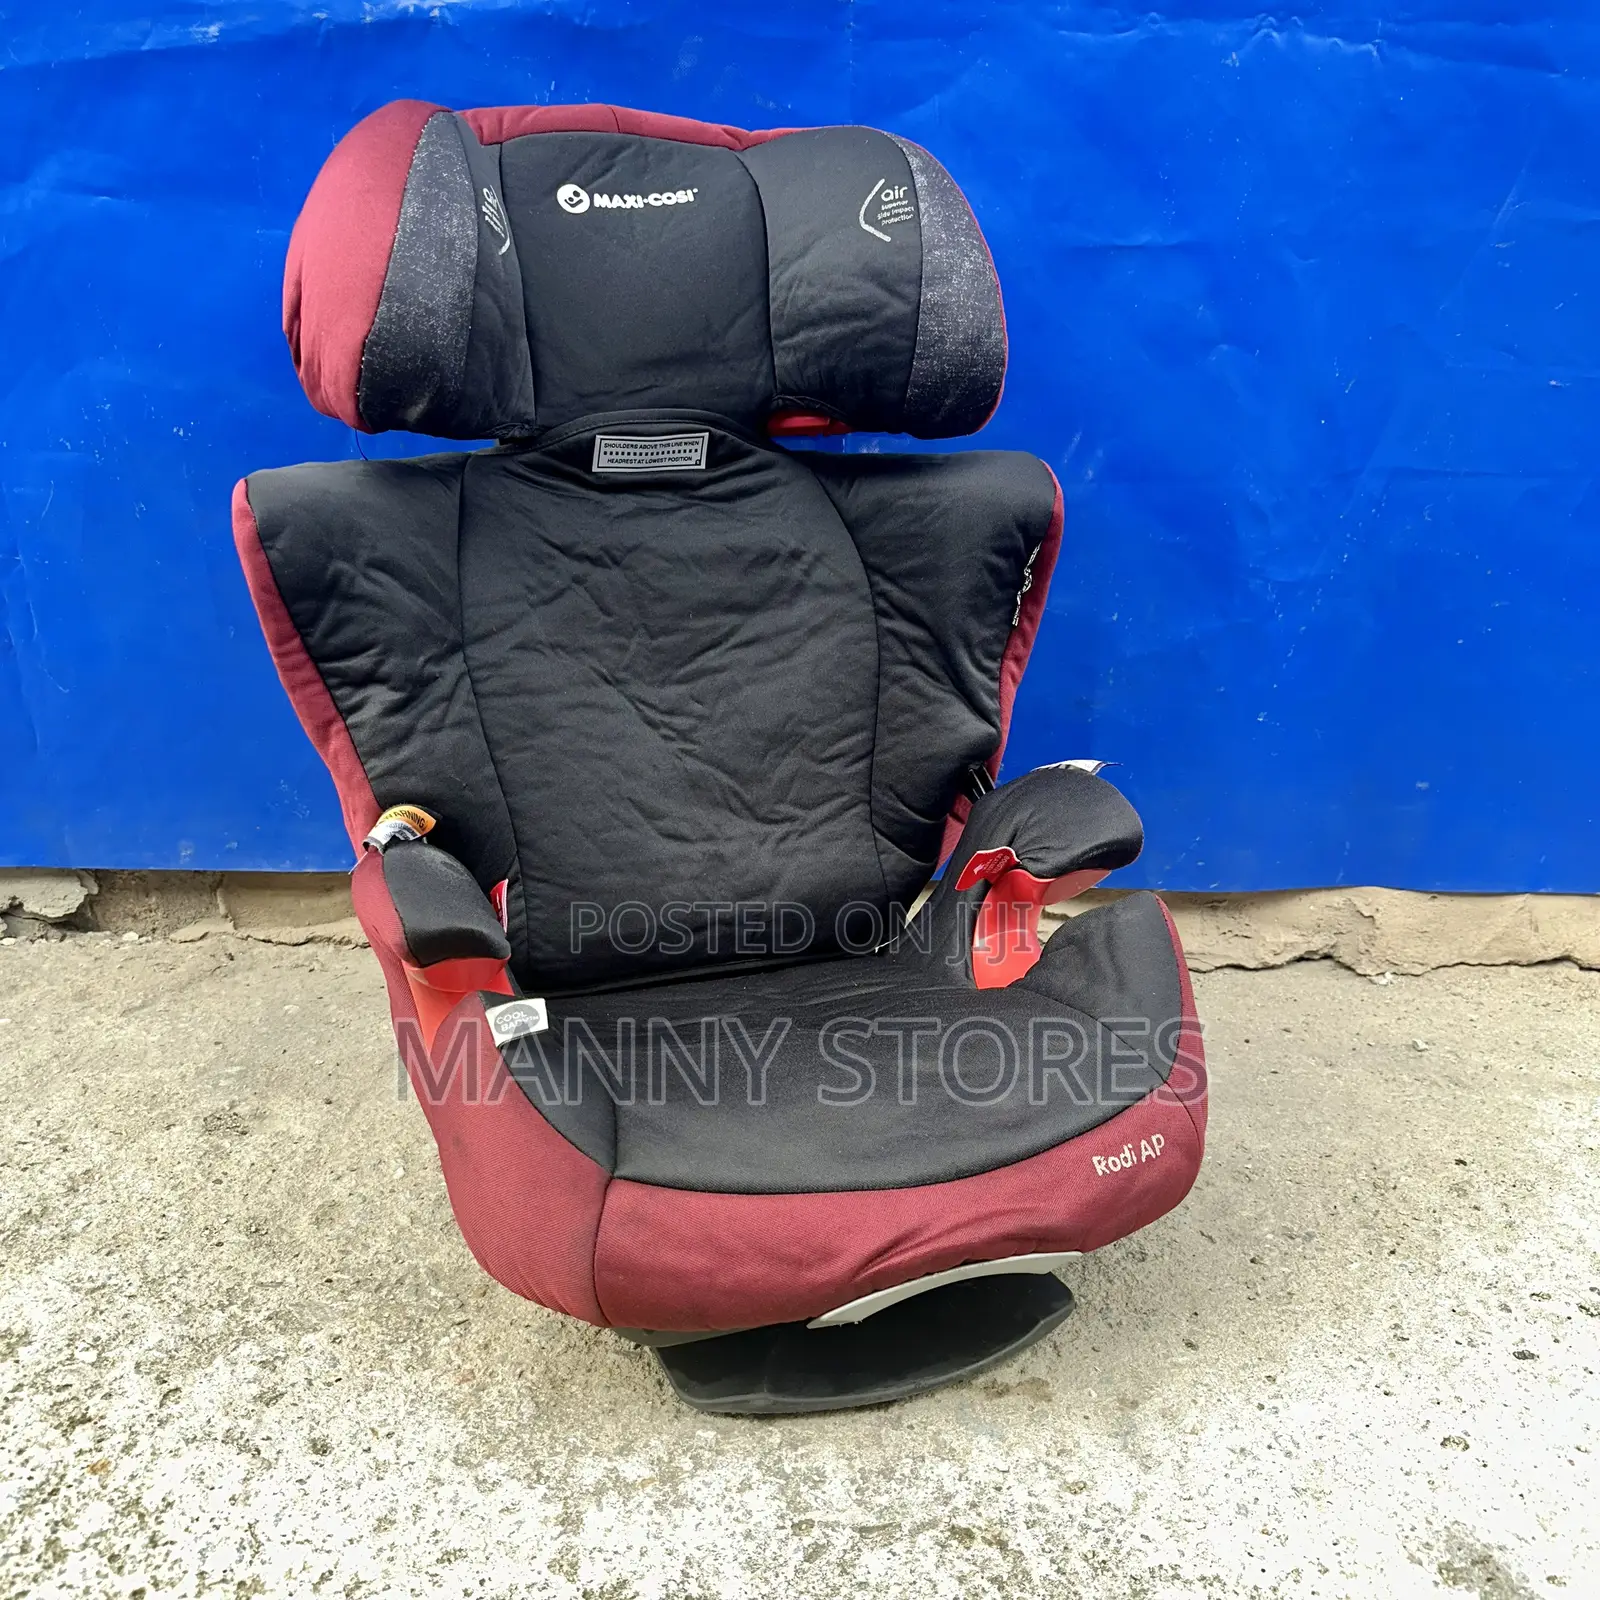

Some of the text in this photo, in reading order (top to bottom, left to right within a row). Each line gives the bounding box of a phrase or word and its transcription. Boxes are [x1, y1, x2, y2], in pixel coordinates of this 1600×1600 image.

[881, 185, 908, 202] air
[645, 457, 668, 465] LOWEST
[667, 455, 693, 463] POSITION
[496, 1010, 528, 1025] COOL
[1091, 1133, 1165, 1177] Rodi AP
